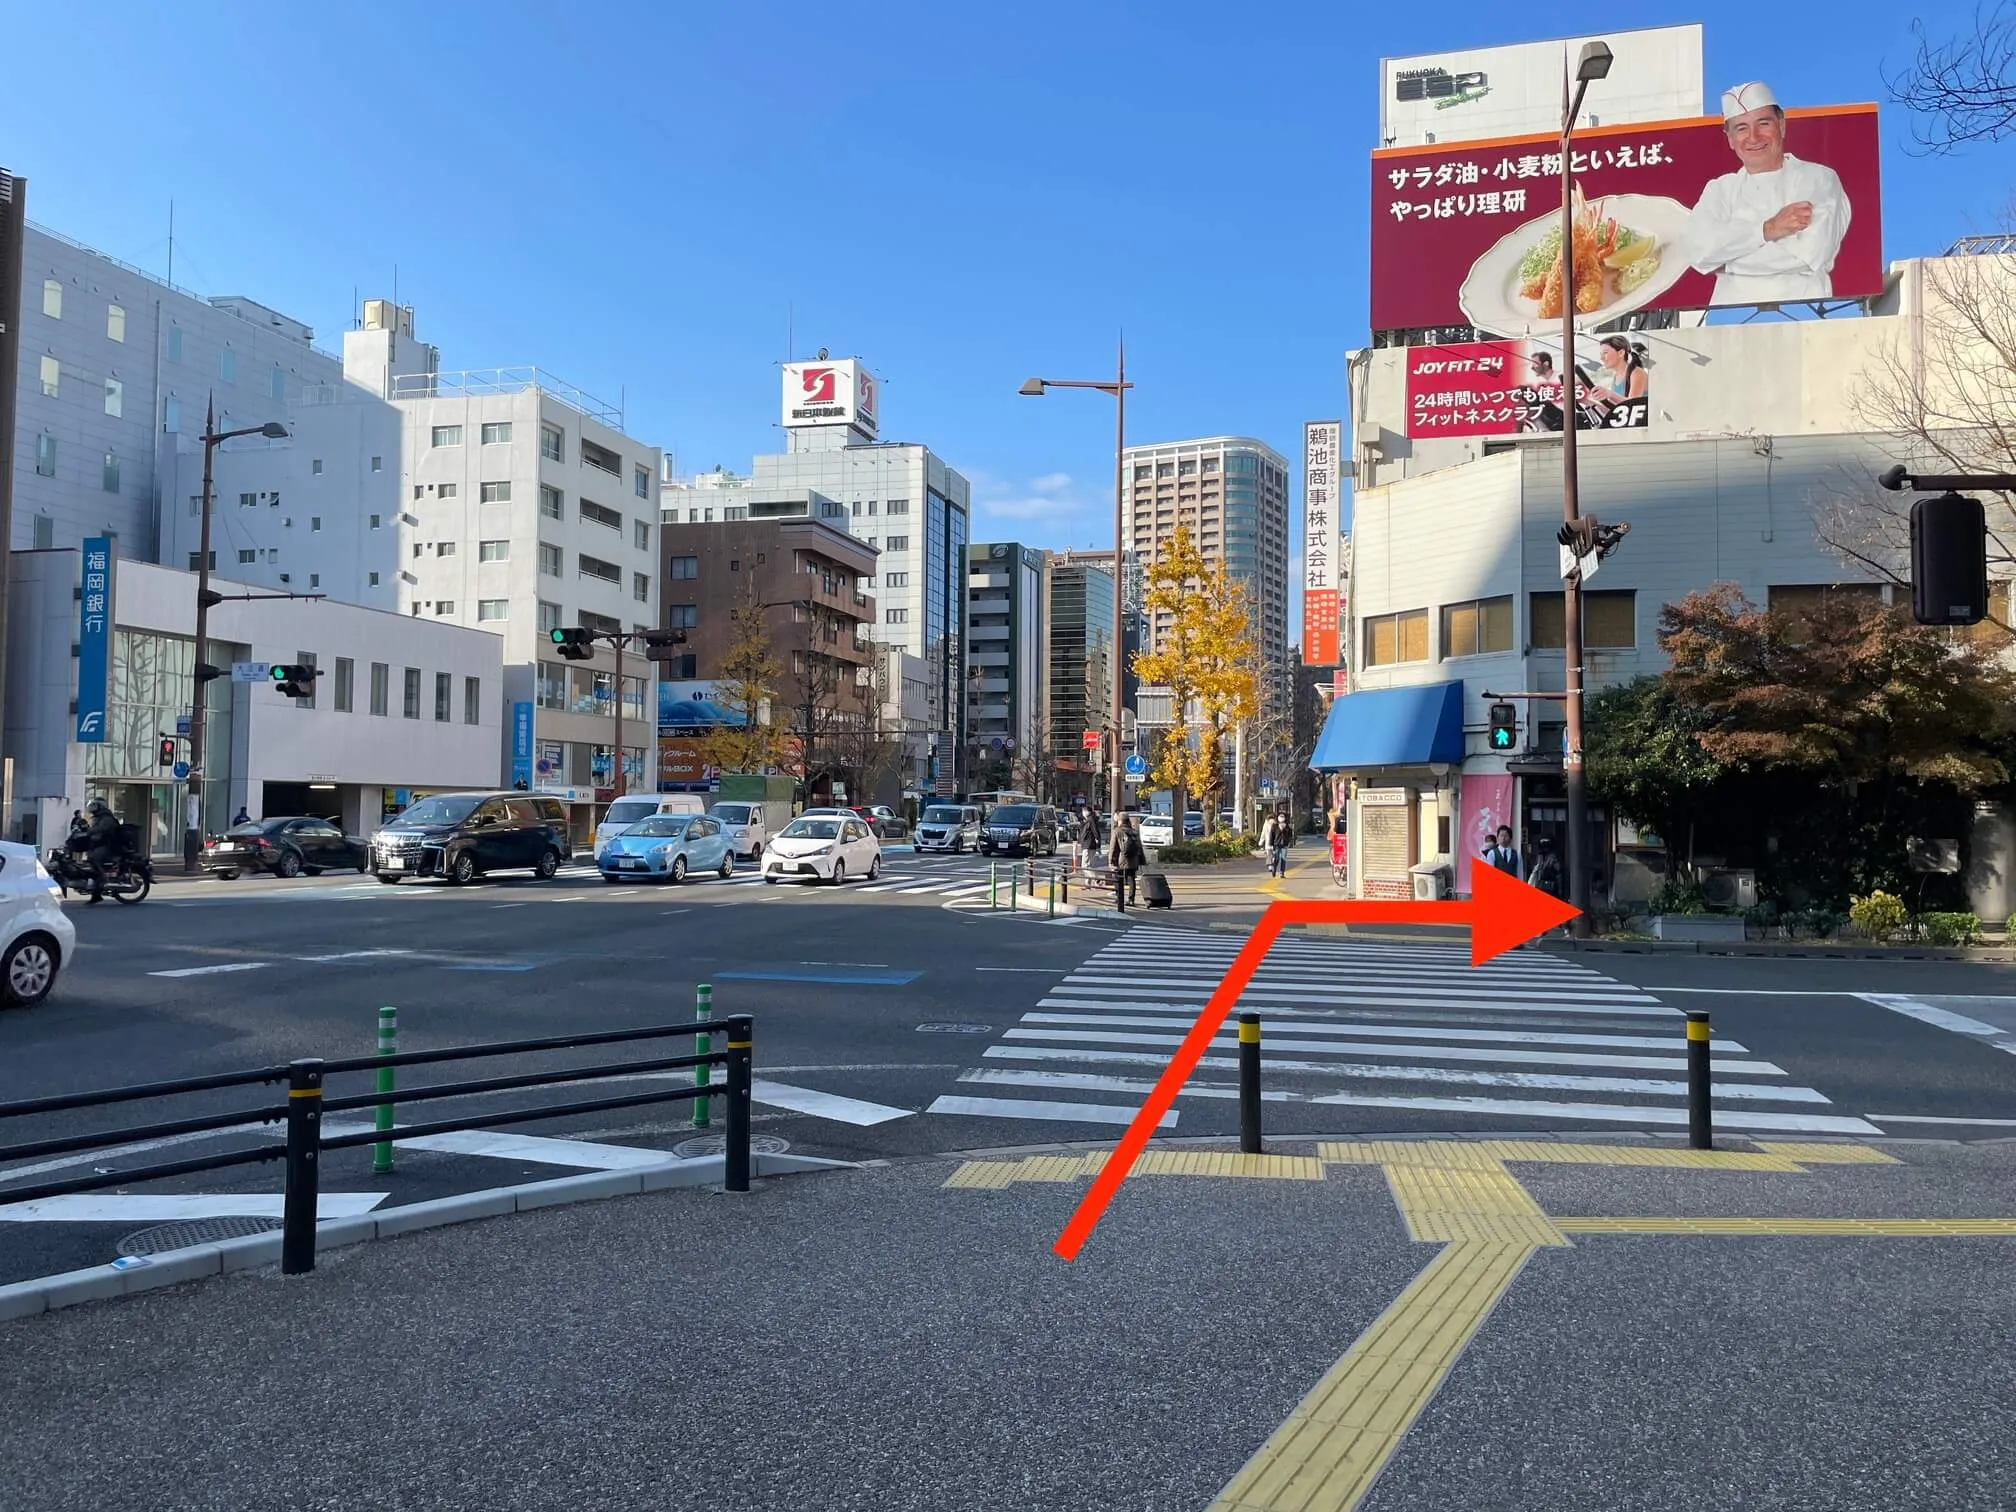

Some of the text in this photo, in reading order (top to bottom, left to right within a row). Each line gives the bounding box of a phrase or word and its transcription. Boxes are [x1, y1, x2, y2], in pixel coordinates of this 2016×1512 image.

[1388, 142, 1674, 190] サラダ油・小麦粉といえば、
[1390, 189, 1526, 222] やっぱり理研
[1477, 356, 1503, 371] 24
[1414, 405, 1545, 427] フィットネスクラブ
[1609, 404, 1647, 428] 3F
[85, 552, 105, 633] 福岡銀行
[1361, 794, 1402, 802] TOBACCO
